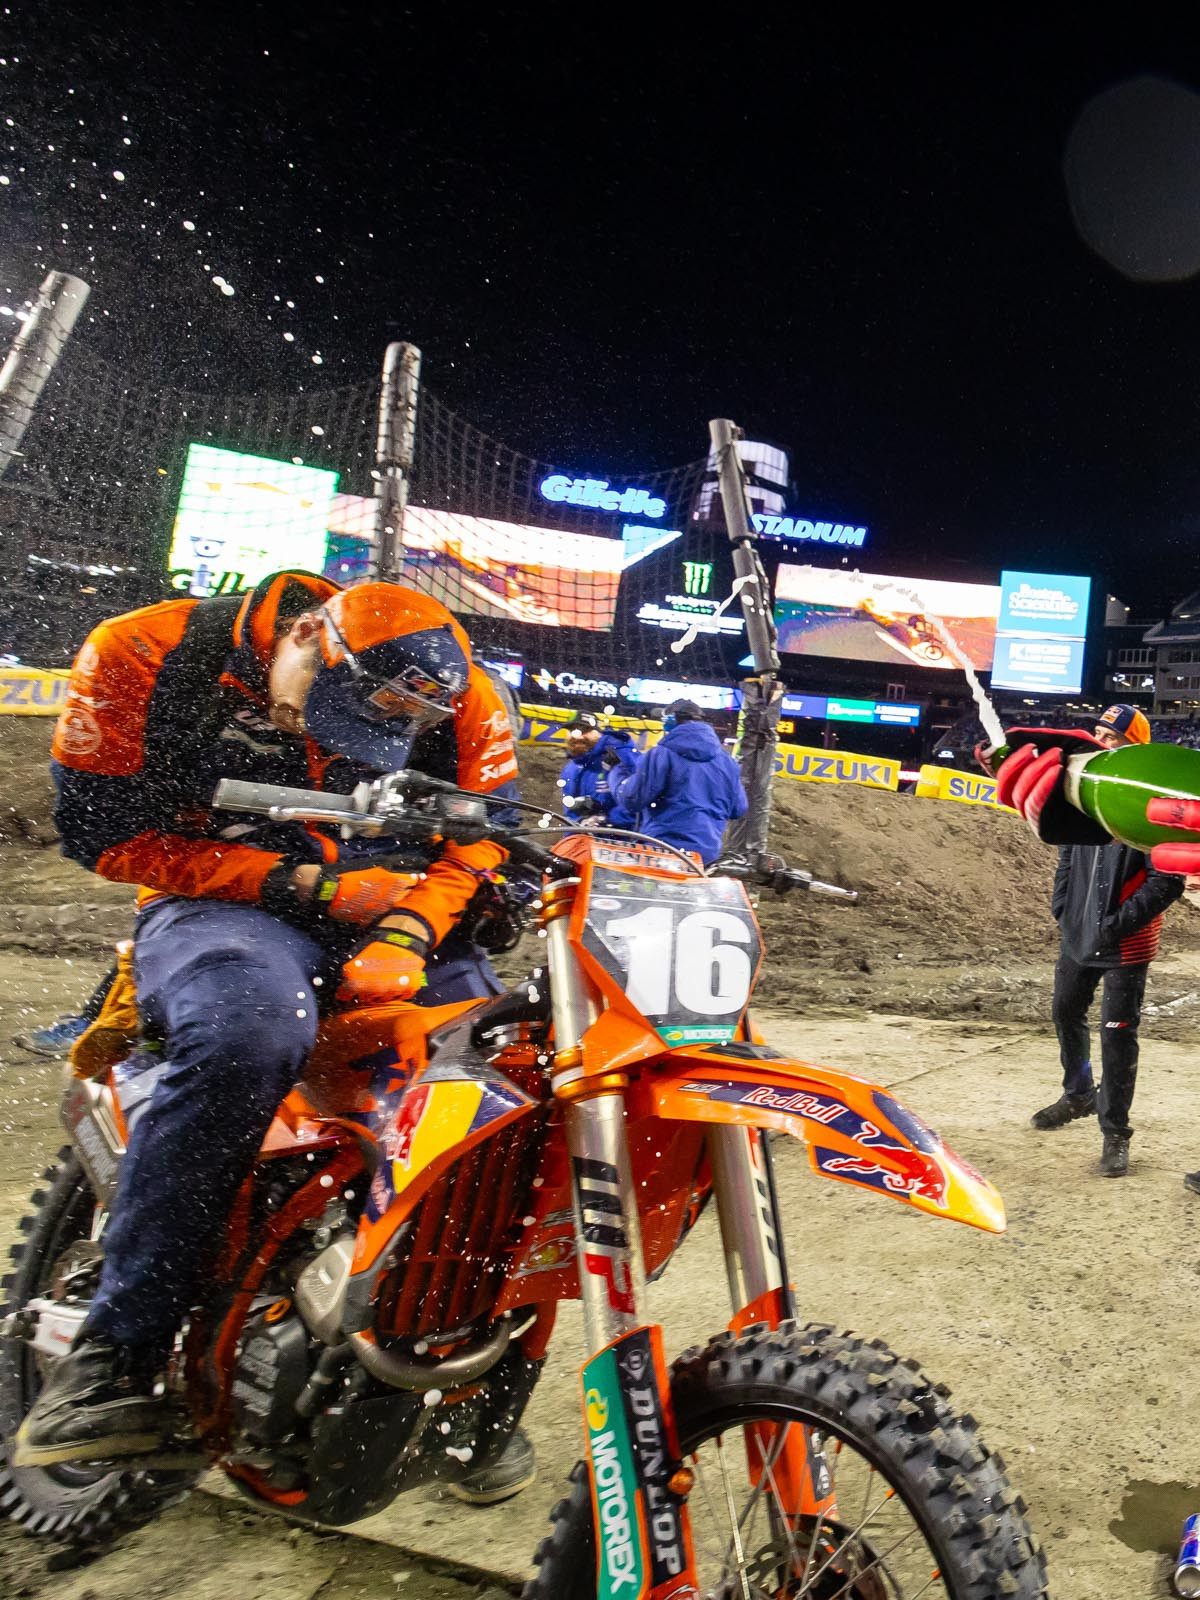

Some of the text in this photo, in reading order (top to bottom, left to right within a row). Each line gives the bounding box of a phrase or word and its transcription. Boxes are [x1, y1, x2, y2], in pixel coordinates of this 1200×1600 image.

[541, 475, 667, 518] Gillette
[751, 513, 867, 546] STADIUM
[949, 777, 1004, 806] SUZ
[606, 906, 752, 1016] 16
[591, 1430, 638, 1595] MOTOREX
[629, 1386, 682, 1576] DUNLOP
